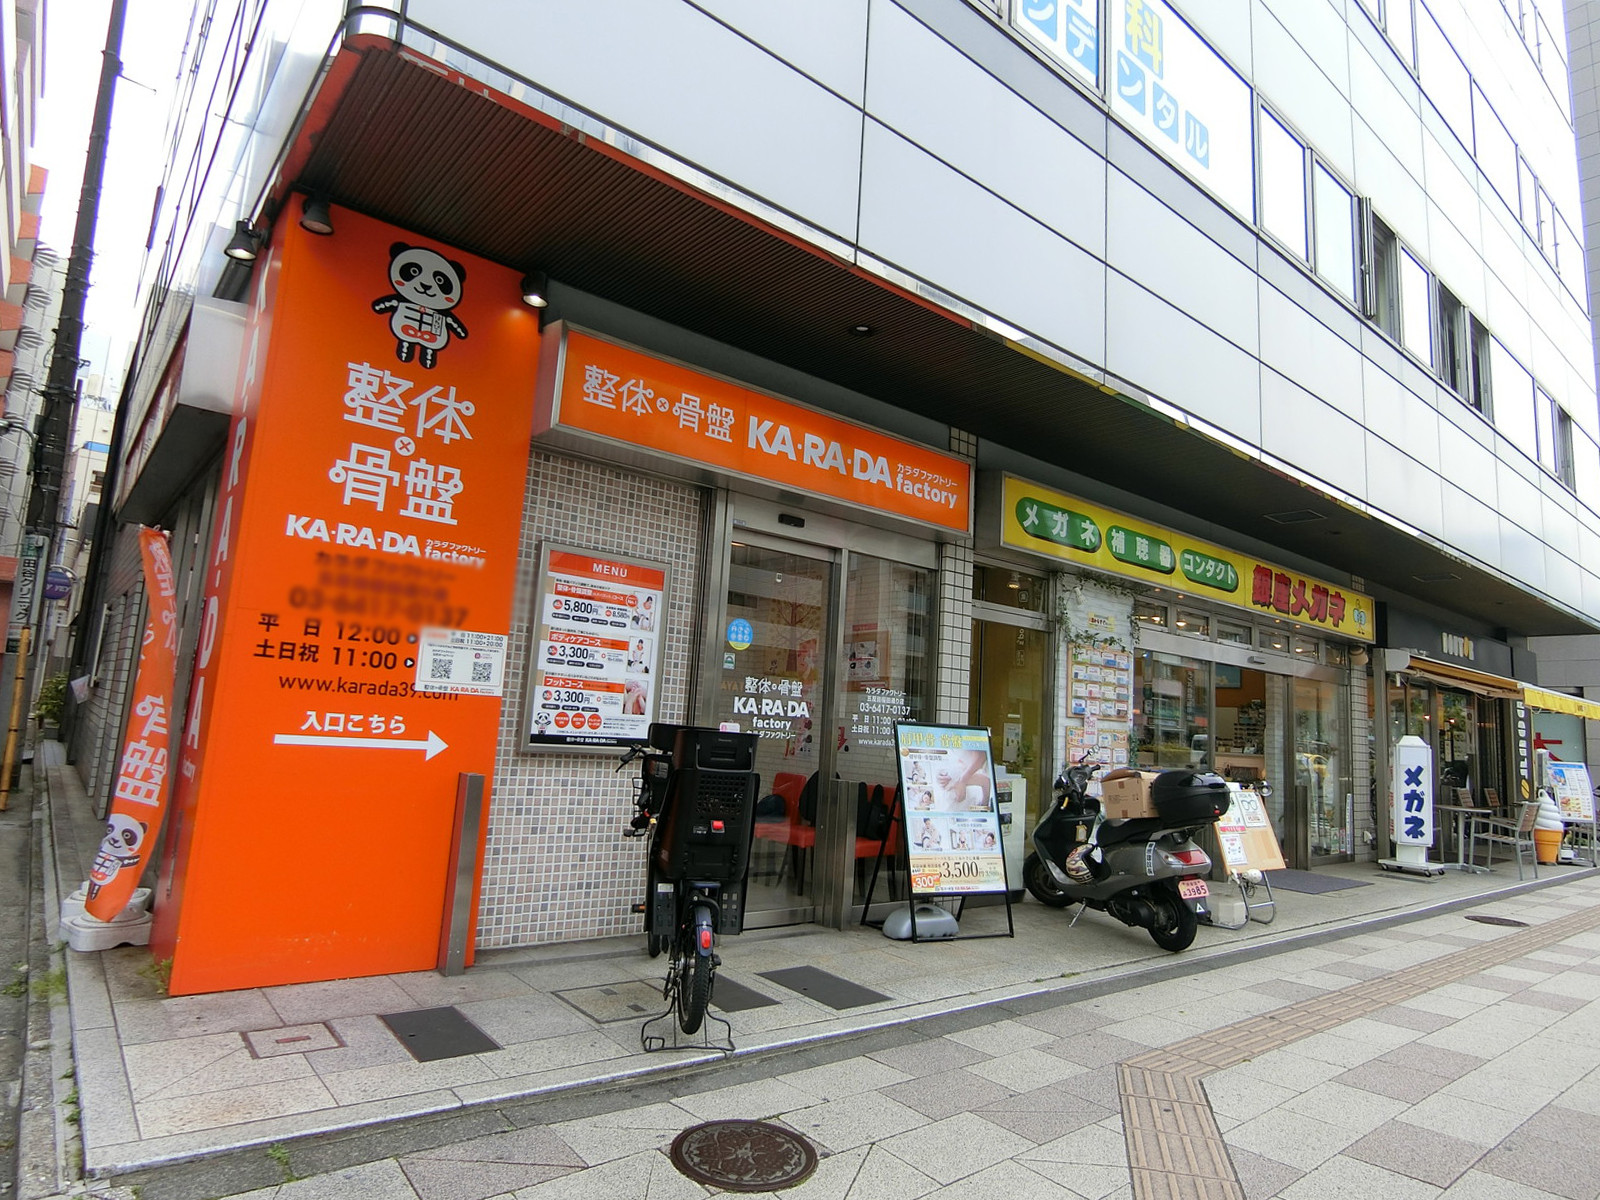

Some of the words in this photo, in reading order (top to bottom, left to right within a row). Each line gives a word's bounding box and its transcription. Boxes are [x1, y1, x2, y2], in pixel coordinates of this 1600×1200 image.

[343, 362, 476, 445] 整体
[328, 442, 464, 526] 骨盤
[897, 463, 958, 488] カラダファクトリー
[896, 473, 958, 509] factory
[1022, 504, 1096, 546] メガネ
[424, 547, 486, 569] factory
[426, 538, 487, 554] カラダファクトリー
[592, 562, 628, 578] MENU
[1183, 553, 1235, 584] コンタクト
[1252, 564, 1346, 628] 銀座メガネ
[253, 639, 320, 663] 土日祝
[332, 647, 398, 670] 11:00
[859, 702, 911, 716] 03-6417-0137
[300, 710, 406, 735] 入口こちら
[752, 716, 792, 730] factory
[1186, 885, 1207, 897] 3985
